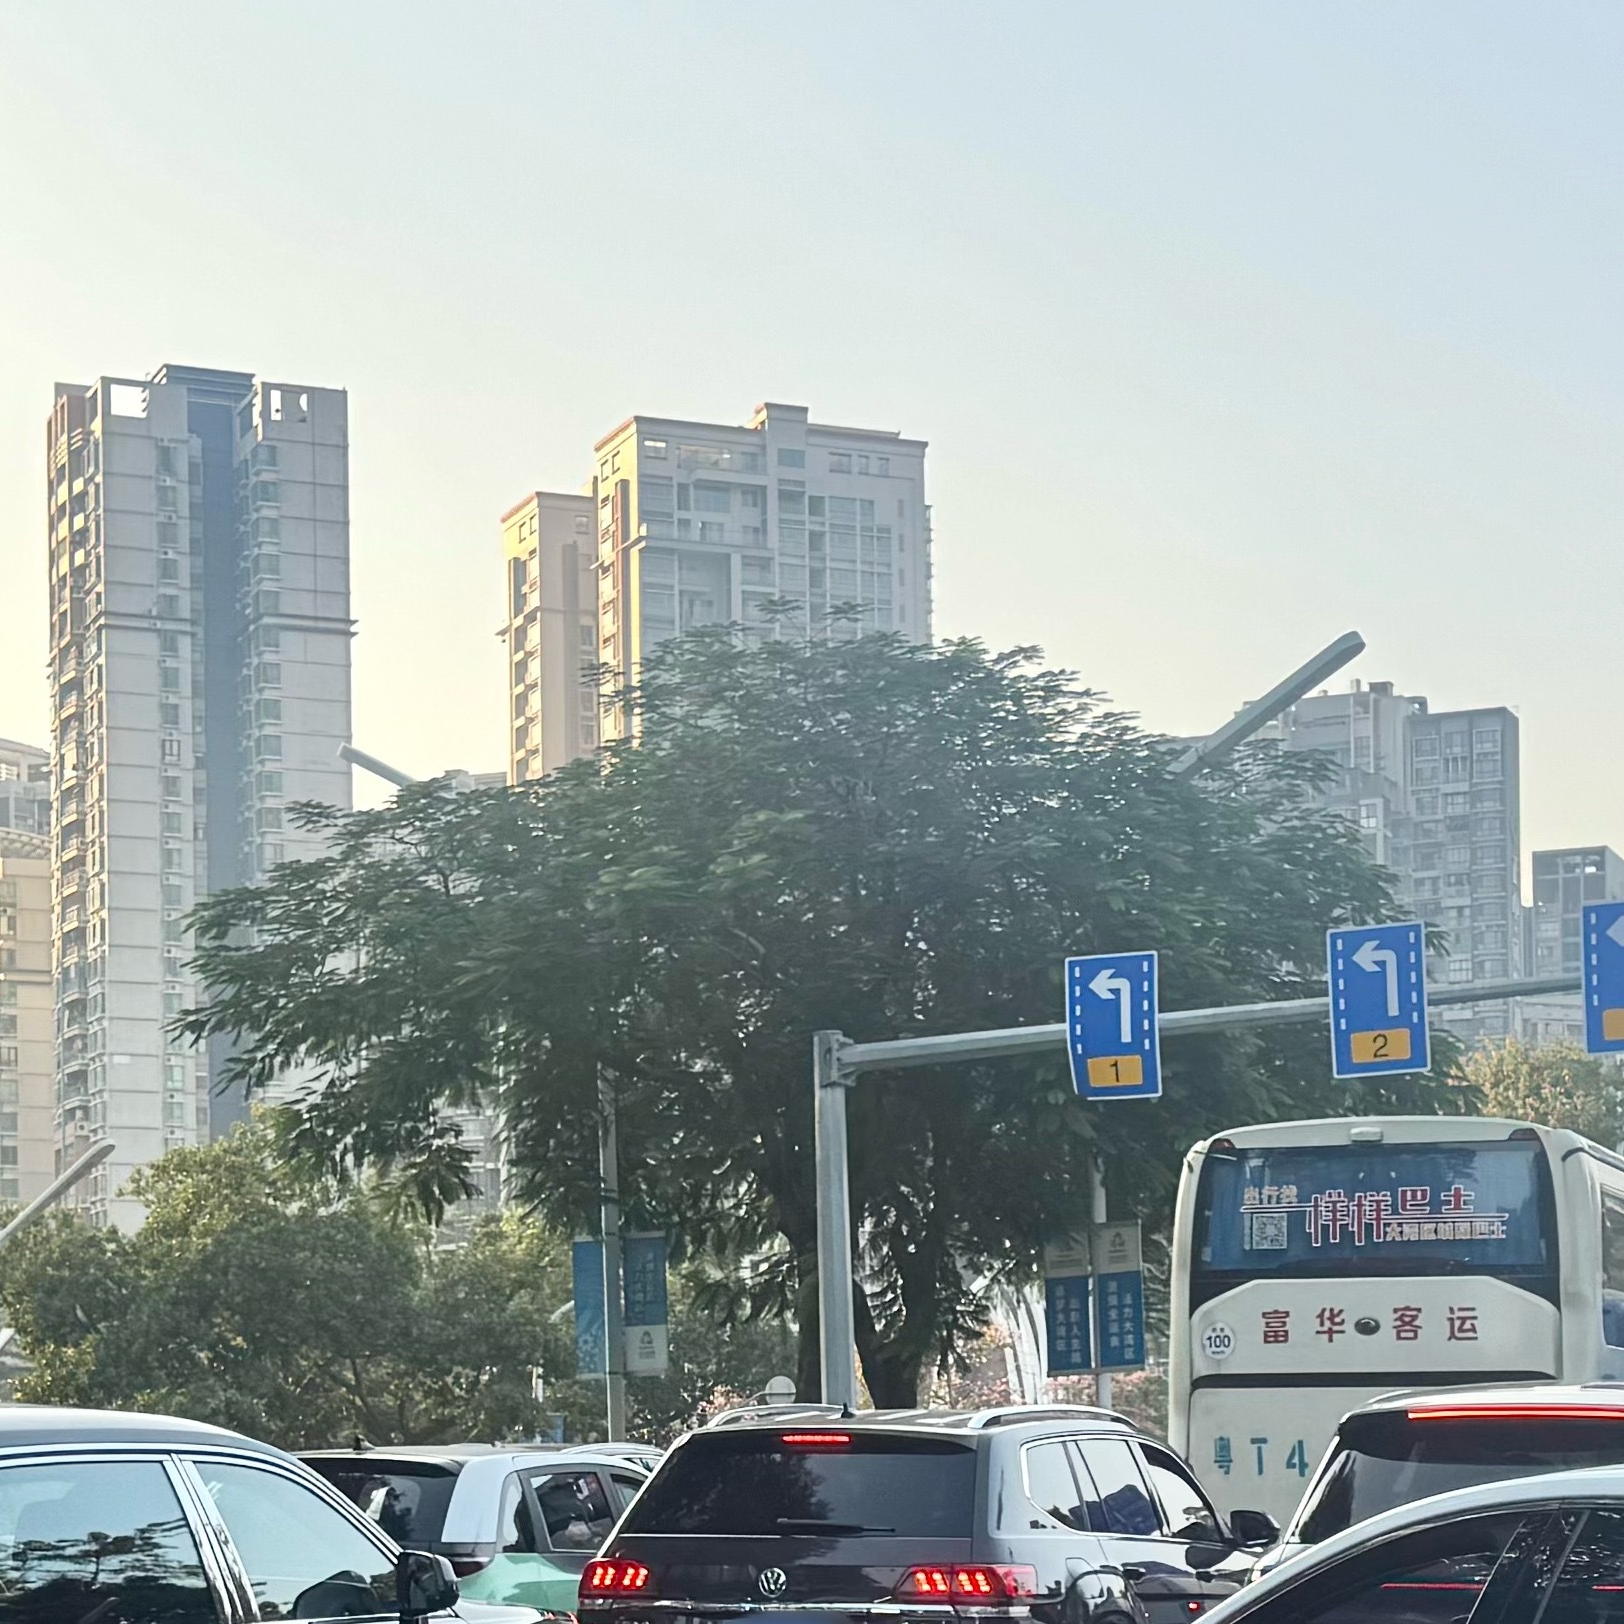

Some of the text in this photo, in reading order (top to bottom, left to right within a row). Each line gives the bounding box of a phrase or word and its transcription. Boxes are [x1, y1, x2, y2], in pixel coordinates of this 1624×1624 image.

[1372, 1033, 1390, 1059] 2
[1109, 1059, 1123, 1083] 1
[1206, 1334, 1231, 1349] 100
